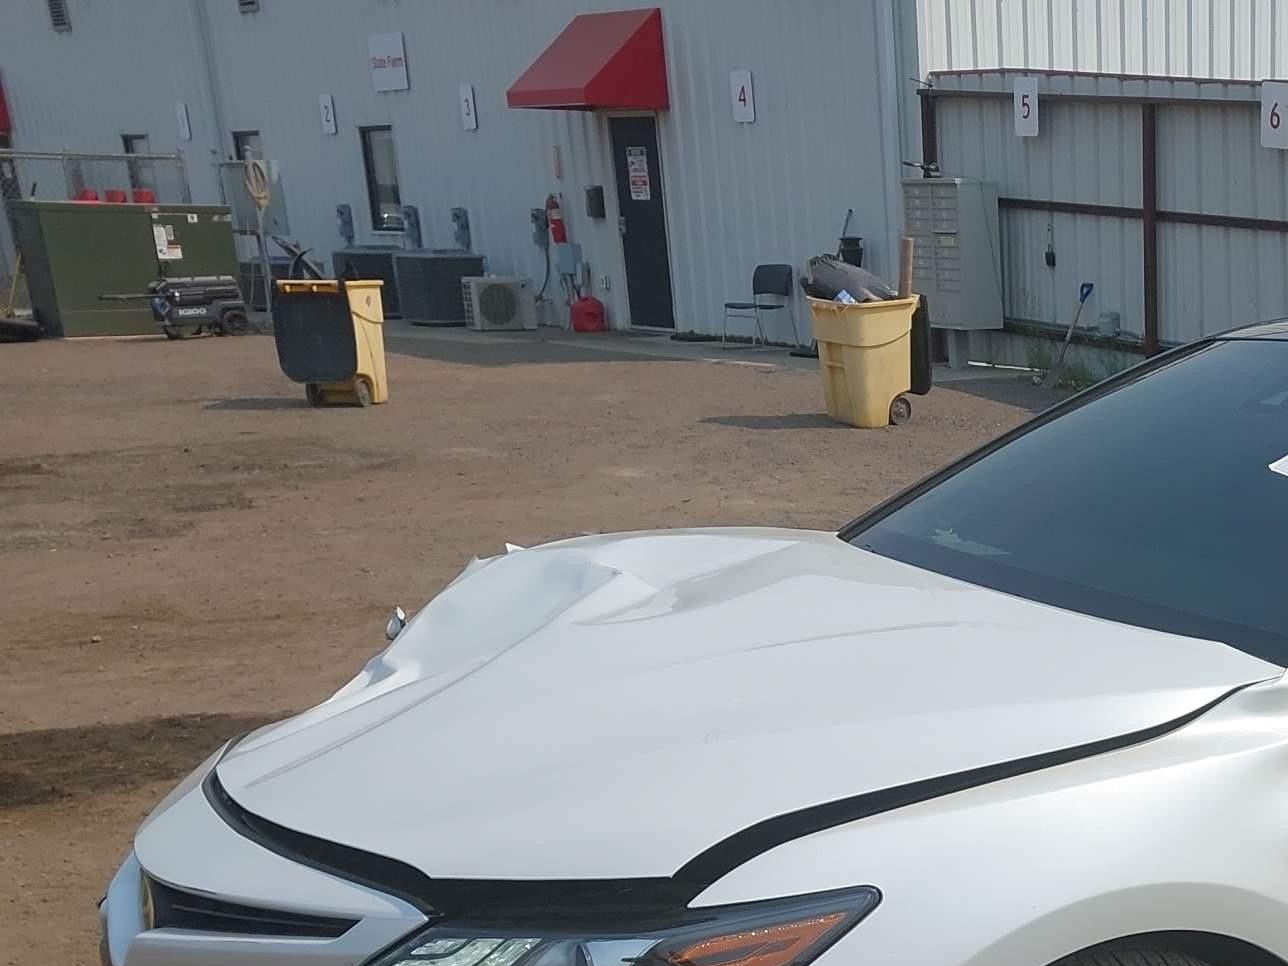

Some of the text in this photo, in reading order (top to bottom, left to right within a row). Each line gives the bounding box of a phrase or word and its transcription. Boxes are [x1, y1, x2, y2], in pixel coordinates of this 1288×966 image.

[371, 55, 404, 69] State Farm
[738, 85, 747, 107] 4
[323, 104, 331, 122] 2
[464, 98, 471, 116] 3
[1022, 94, 1031, 119] 5
[1270, 101, 1281, 130] 6
